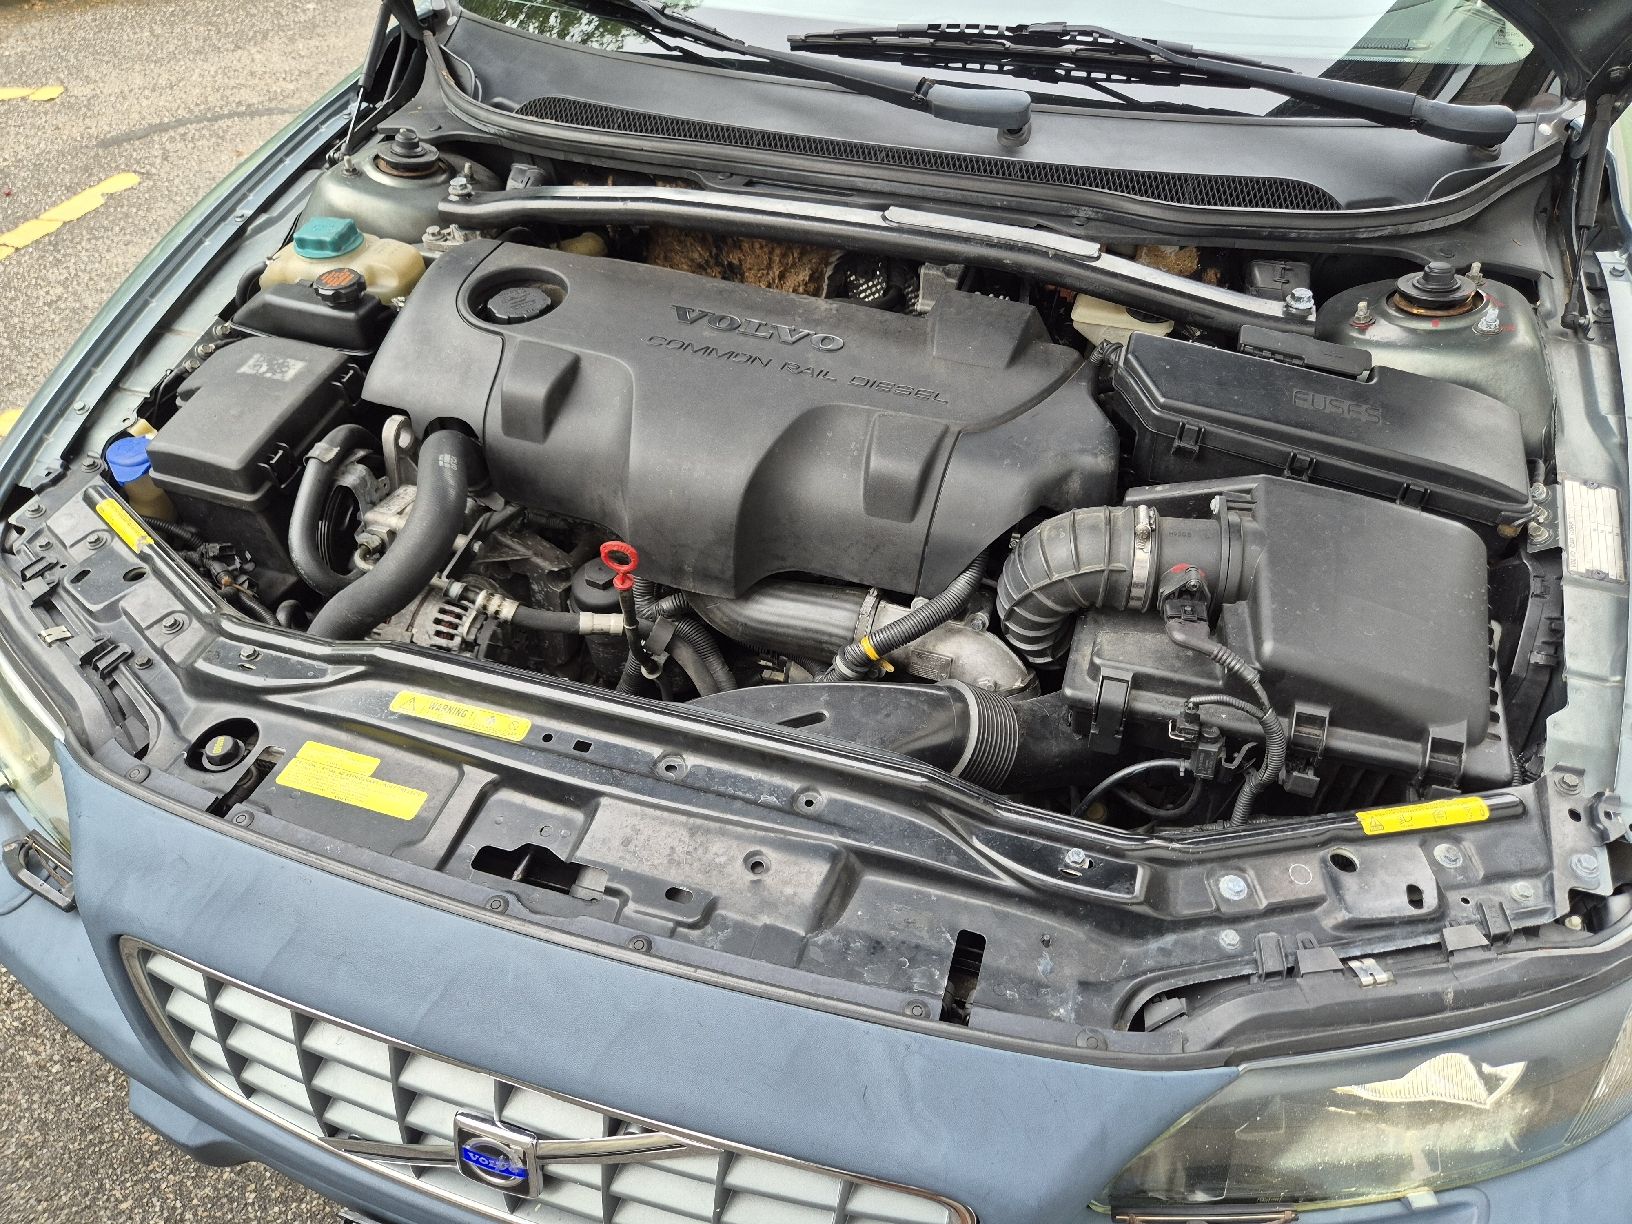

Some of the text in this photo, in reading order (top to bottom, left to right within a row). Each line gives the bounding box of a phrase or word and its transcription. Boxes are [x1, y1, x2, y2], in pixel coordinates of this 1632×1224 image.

[670, 304, 844, 352] VOLVO
[648, 336, 949, 405] COMMON RAIL DIESEL
[1293, 390, 1381, 424] FUSES
[428, 701, 469, 718] WARNING
